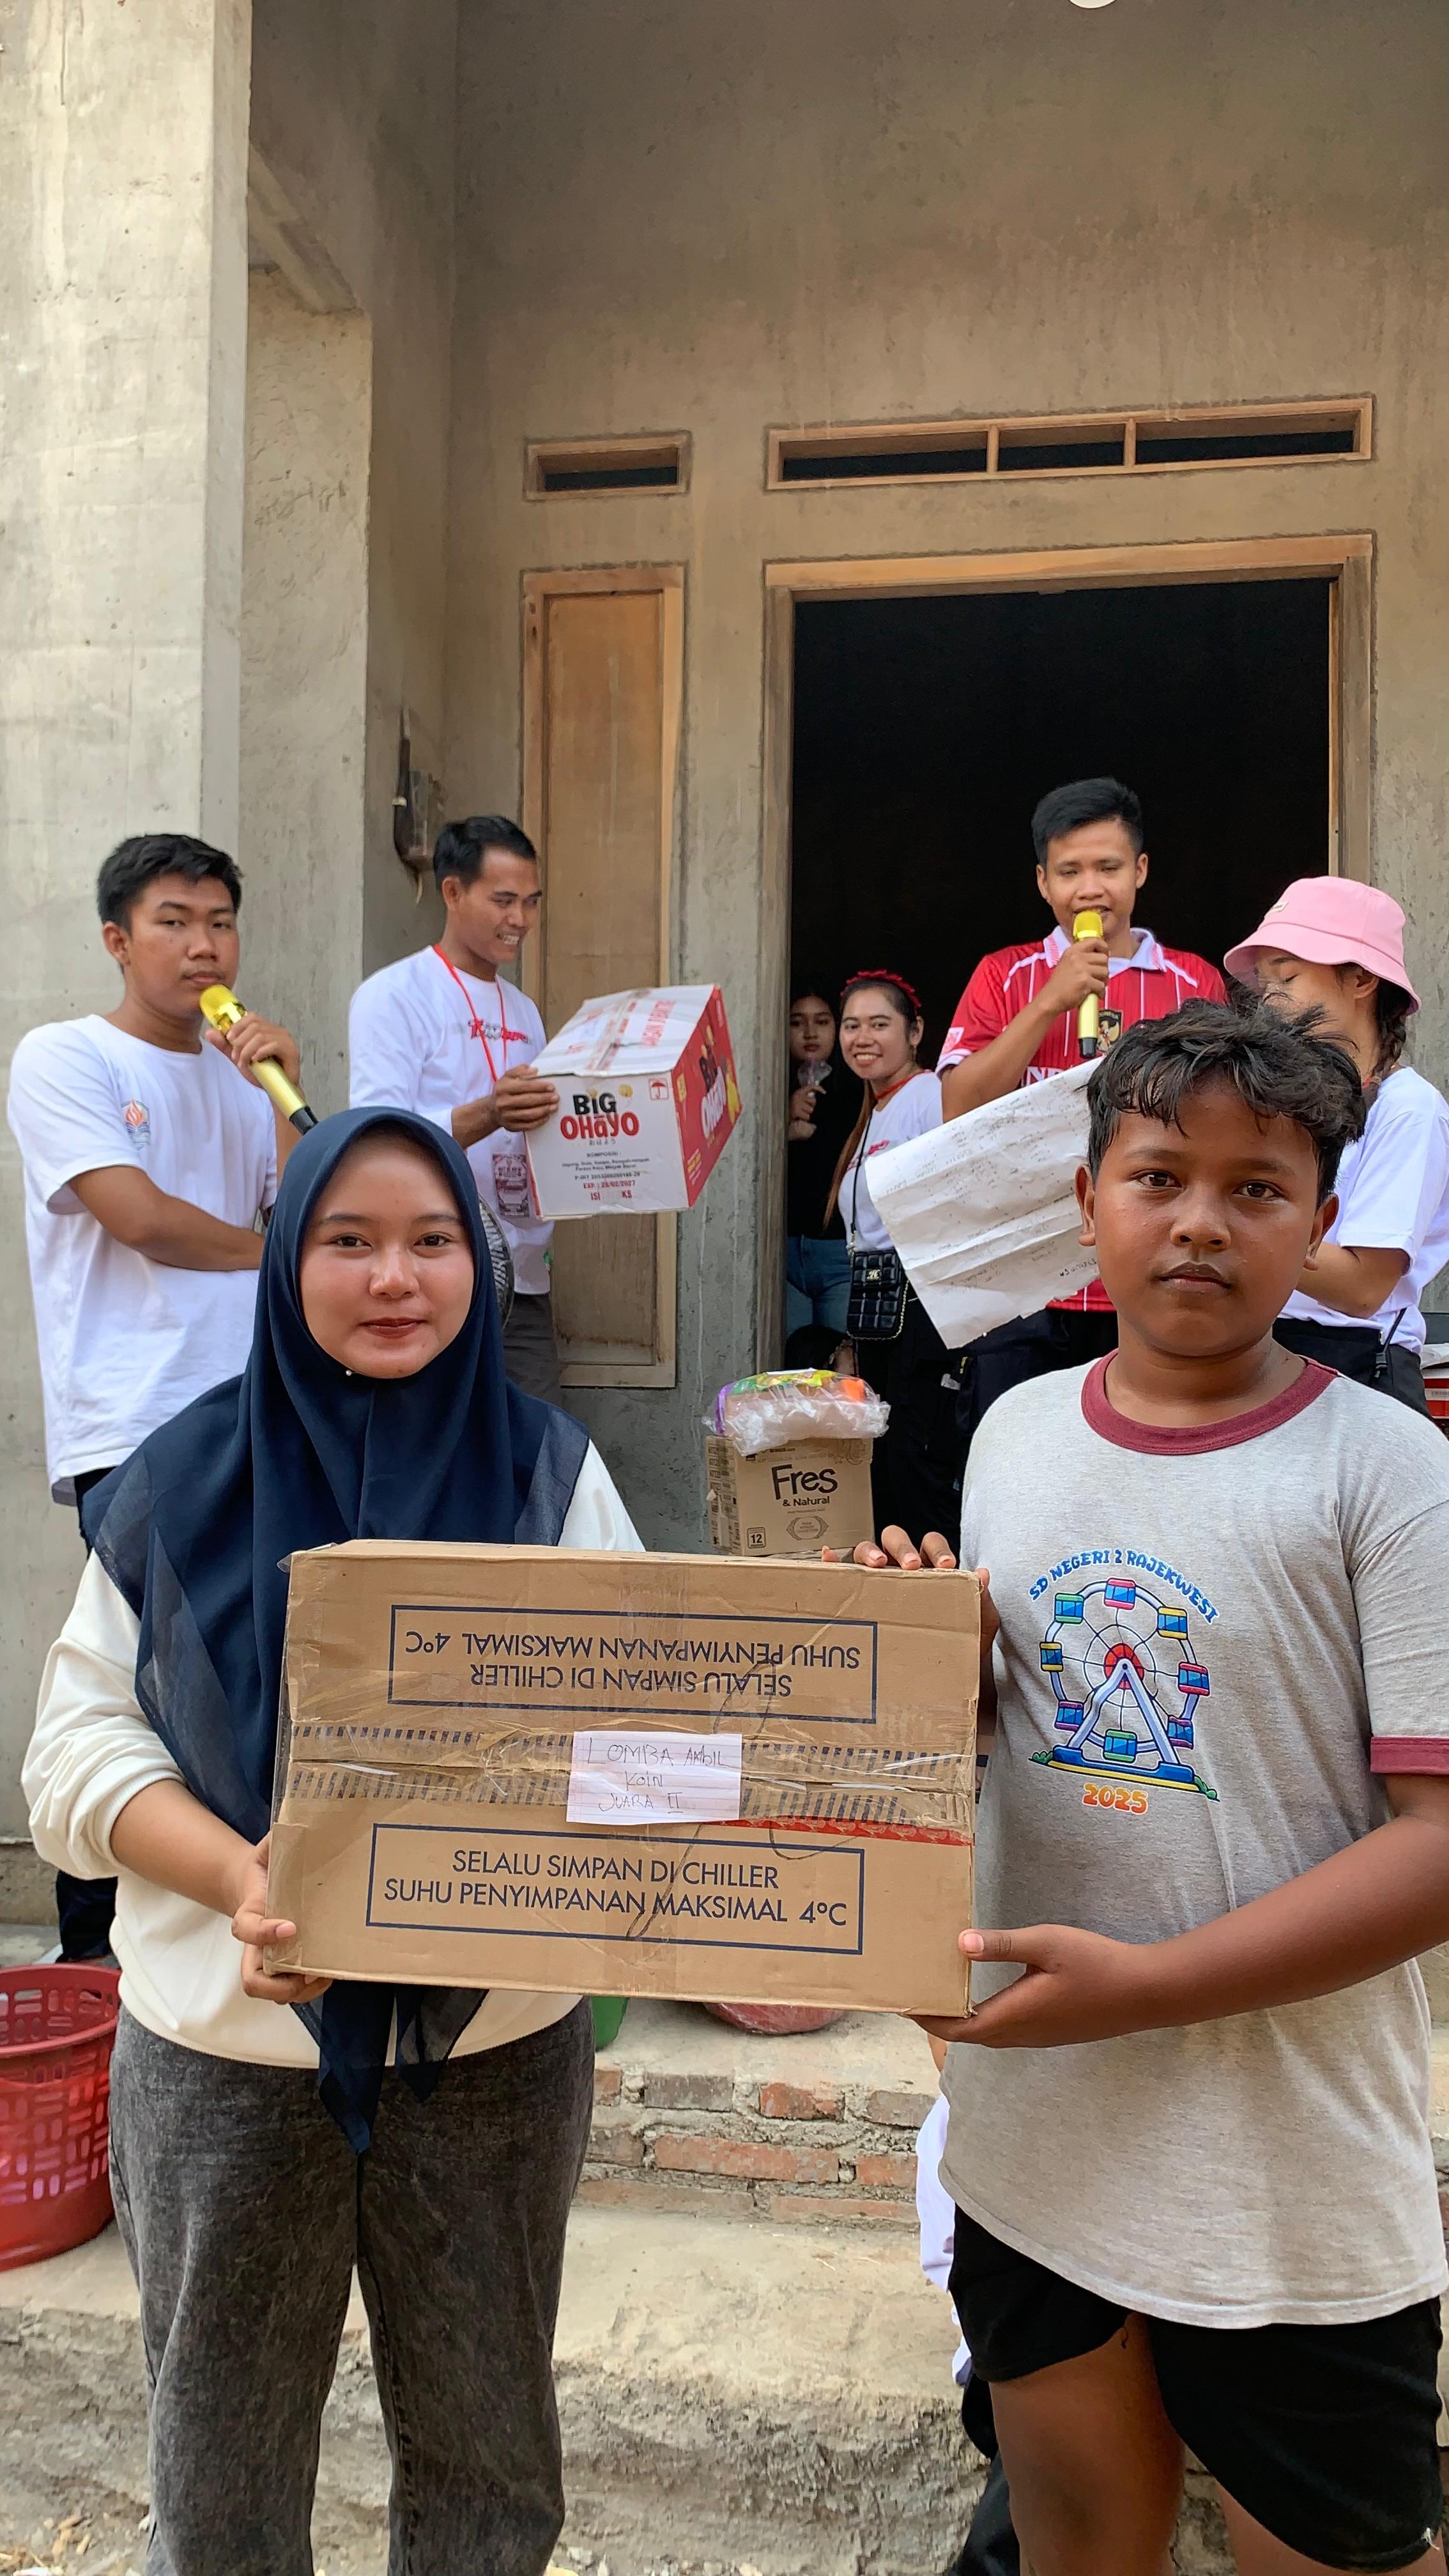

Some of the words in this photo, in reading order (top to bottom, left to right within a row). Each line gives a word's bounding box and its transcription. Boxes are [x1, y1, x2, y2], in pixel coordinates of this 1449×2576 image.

[772, 1464, 838, 1500] Fres
[793, 1496, 830, 1506] Natural
[751, 1534, 762, 1544] 12
[1029, 1575, 1048, 1600] SD
[1050, 1551, 1110, 1581] NEGERI
[1115, 1549, 1123, 1563] 2
[1127, 1551, 1218, 1623] RAJEKWESI
[462, 1633, 593, 1659] MAKSIMAL
[600, 1637, 783, 1665] PENYIMPANAN
[791, 1644, 861, 1669] SUHU
[470, 1664, 564, 1688] CHILLER
[571, 1667, 595, 1689] DI
[603, 1668, 698, 1692] SIMPAN
[703, 1672, 792, 1697] SELALU
[587, 1737, 673, 1766] LOMBA
[599, 1793, 654, 1812] JUARA
[1083, 1784, 1148, 1813] 2025
[452, 1850, 540, 1876] SELALU
[547, 1855, 642, 1882] SIMPAN
[650, 1860, 675, 1883] DI
[682, 1862, 779, 1889] CHILLER
[384, 1878, 452, 1903] SUHU
[460, 1882, 645, 1914] PENYIMPANAN
[652, 1892, 788, 1922] MAKSIMAL
